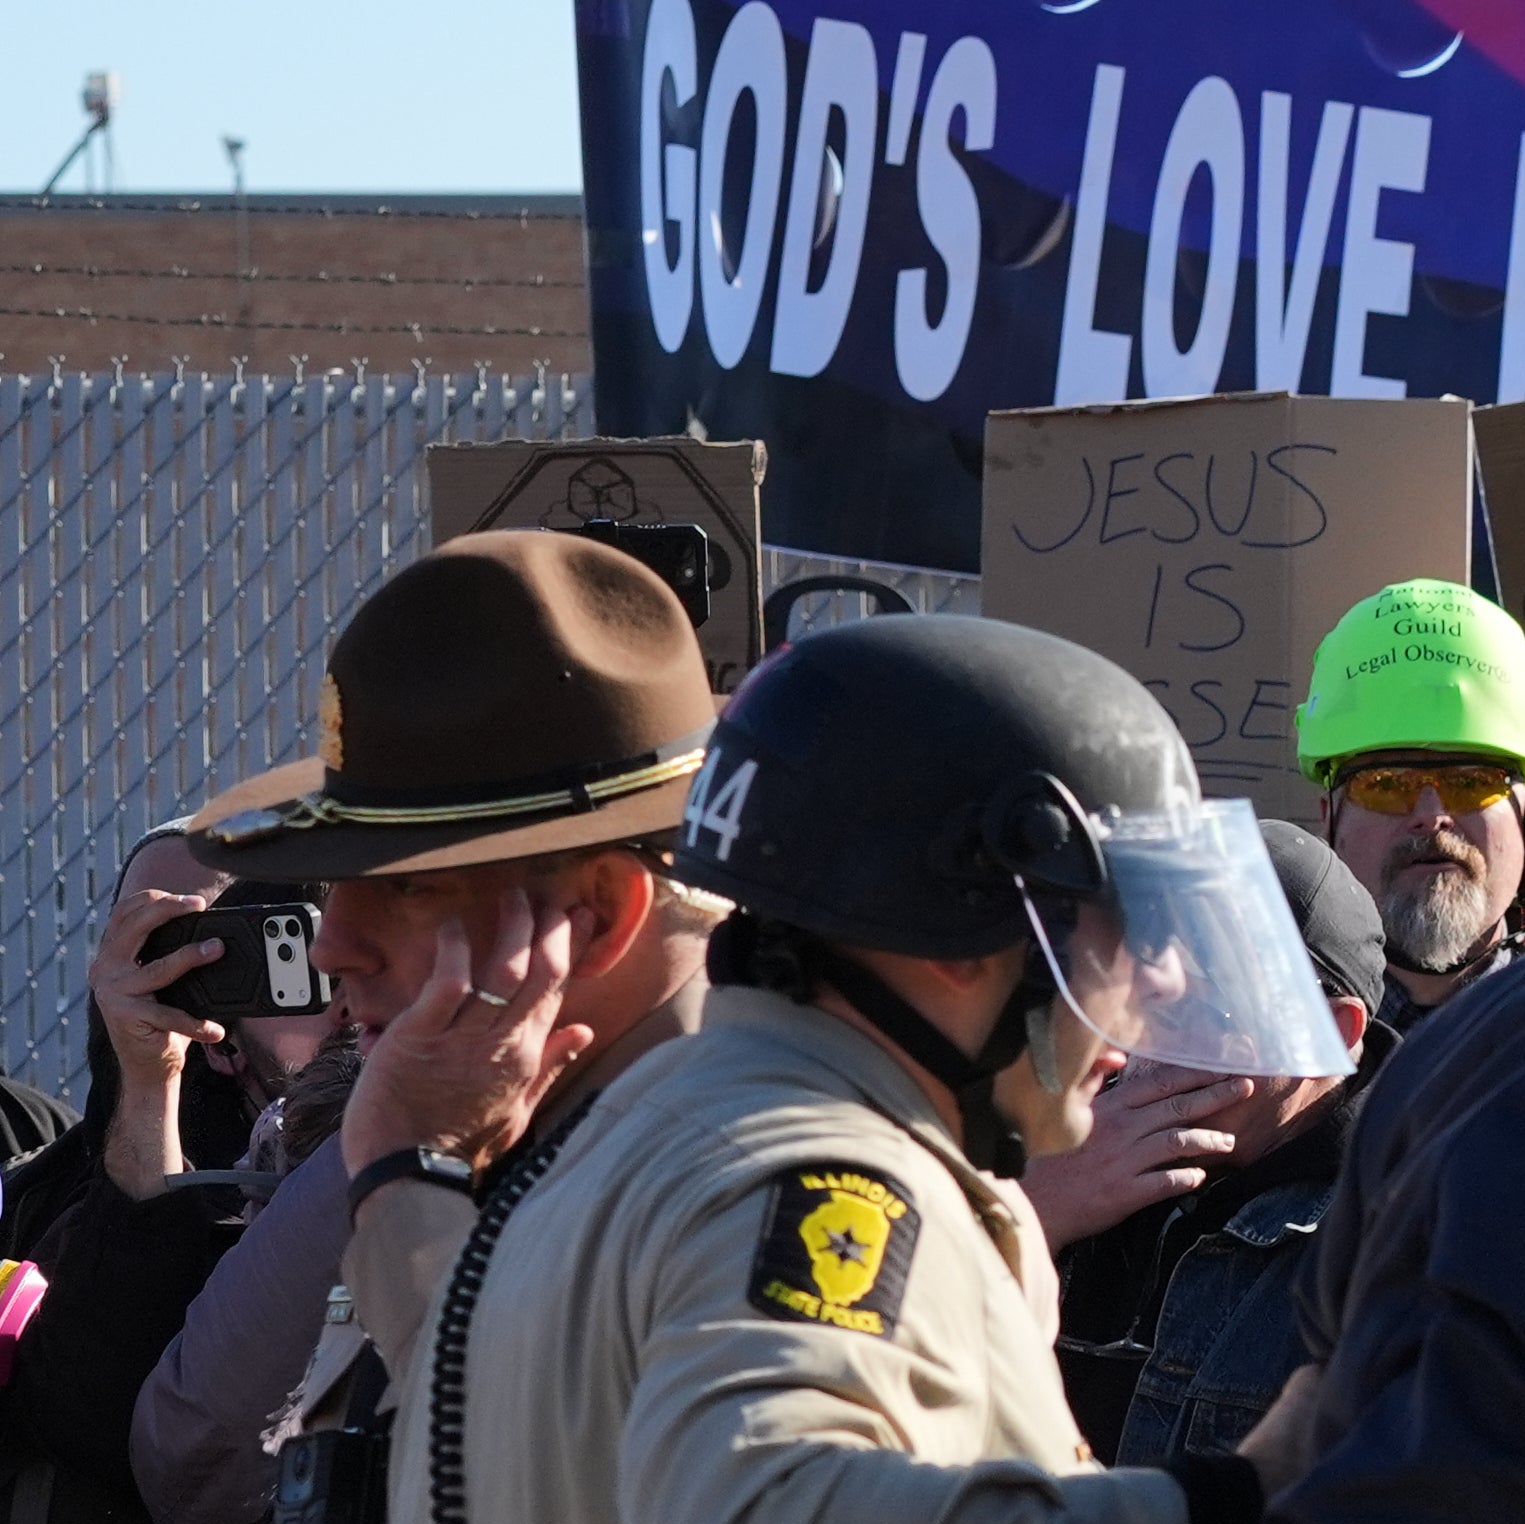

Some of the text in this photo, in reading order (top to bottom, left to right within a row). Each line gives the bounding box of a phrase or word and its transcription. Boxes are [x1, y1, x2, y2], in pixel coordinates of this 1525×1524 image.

[642, 0, 998, 402] GOD'S
[1054, 64, 1432, 407] LOVE
[1012, 445, 1337, 552] JESUS
[1146, 565, 1244, 651] IS
[1375, 602, 1476, 619] Lawyers
[1394, 617, 1462, 637] Guild
[1346, 647, 1397, 680] Legal
[684, 747, 758, 862] 44
